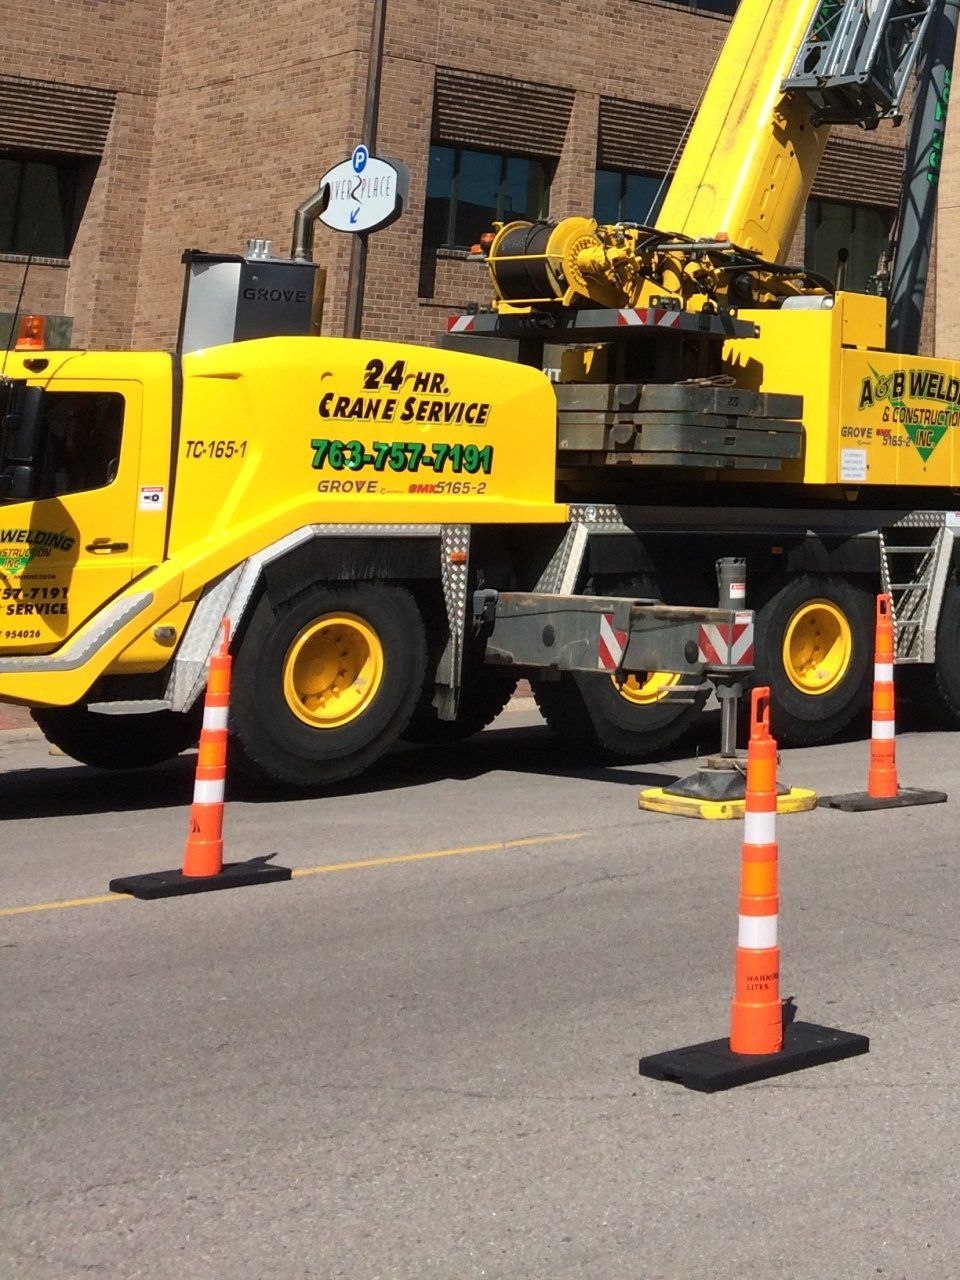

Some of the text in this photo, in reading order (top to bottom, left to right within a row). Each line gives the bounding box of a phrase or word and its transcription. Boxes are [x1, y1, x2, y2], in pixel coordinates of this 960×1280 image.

[355, 151, 366, 169] P
[330, 176, 391, 201] IVER PLACE
[243, 288, 307, 303] GROVE
[363, 358, 450, 394] 24 HR.
[318, 392, 490, 425] CRANE SERVICE
[841, 426, 873, 439] GROVE
[882, 435, 911, 447] 5165-2
[186, 440, 248, 458] TC-165-1
[311, 439, 494, 475] 763-757-7191
[317, 480, 378, 493] GROVE
[1, 529, 76, 552] WELDING
[0, 548, 52, 558] STRUCTION
[0, 587, 68, 600] 57-7191
[6, 603, 67, 615] SERVICE
[5, 629, 41, 639] 954026
